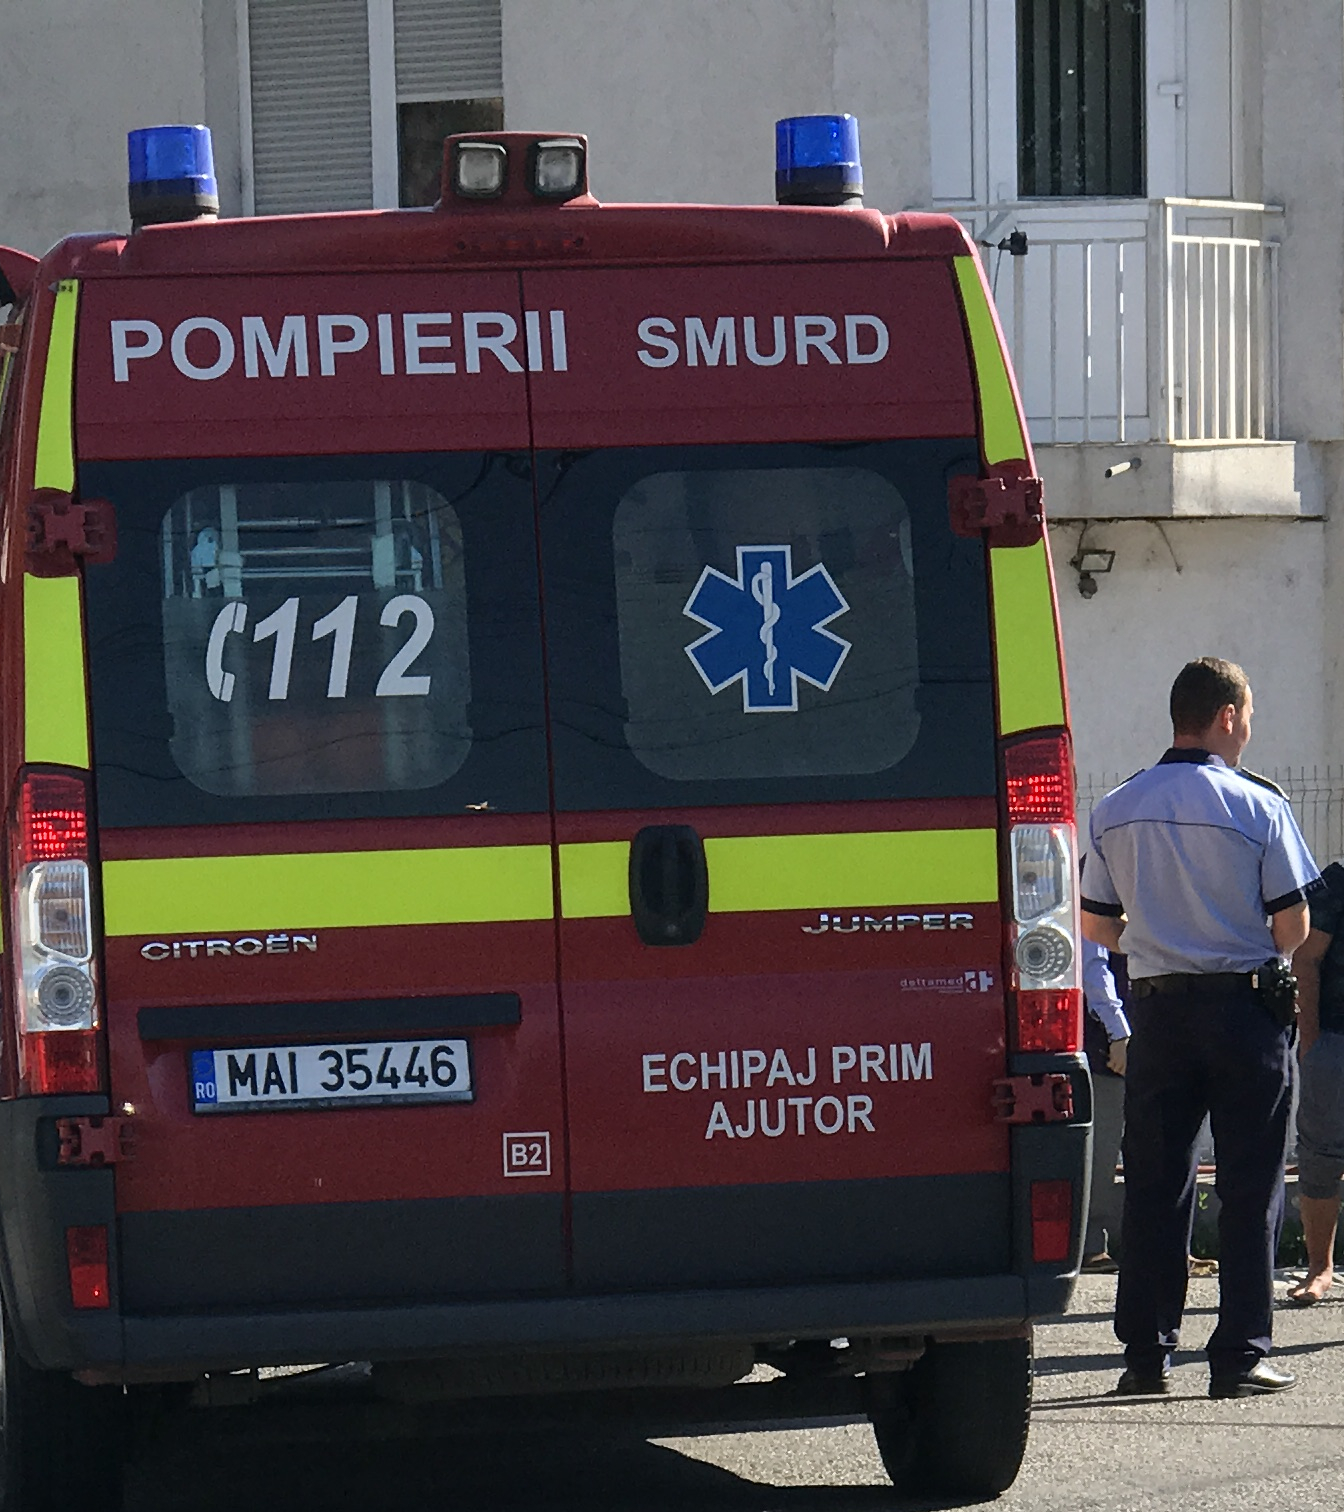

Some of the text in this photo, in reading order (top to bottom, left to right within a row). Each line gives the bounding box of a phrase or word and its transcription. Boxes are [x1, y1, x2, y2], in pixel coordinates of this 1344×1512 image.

[110, 310, 890, 382] POMPIERII SMURD
[253, 594, 435, 700] 112
[801, 913, 974, 935] JUMPER
[140, 933, 318, 961] CITROËN
[227, 1044, 458, 1097] MAI 35446
[642, 1042, 933, 1092] ECHIPAJ PRIM
[195, 1081, 216, 1099] RO
[705, 1094, 876, 1139] AJUTOR
[511, 1143, 543, 1166] B2
